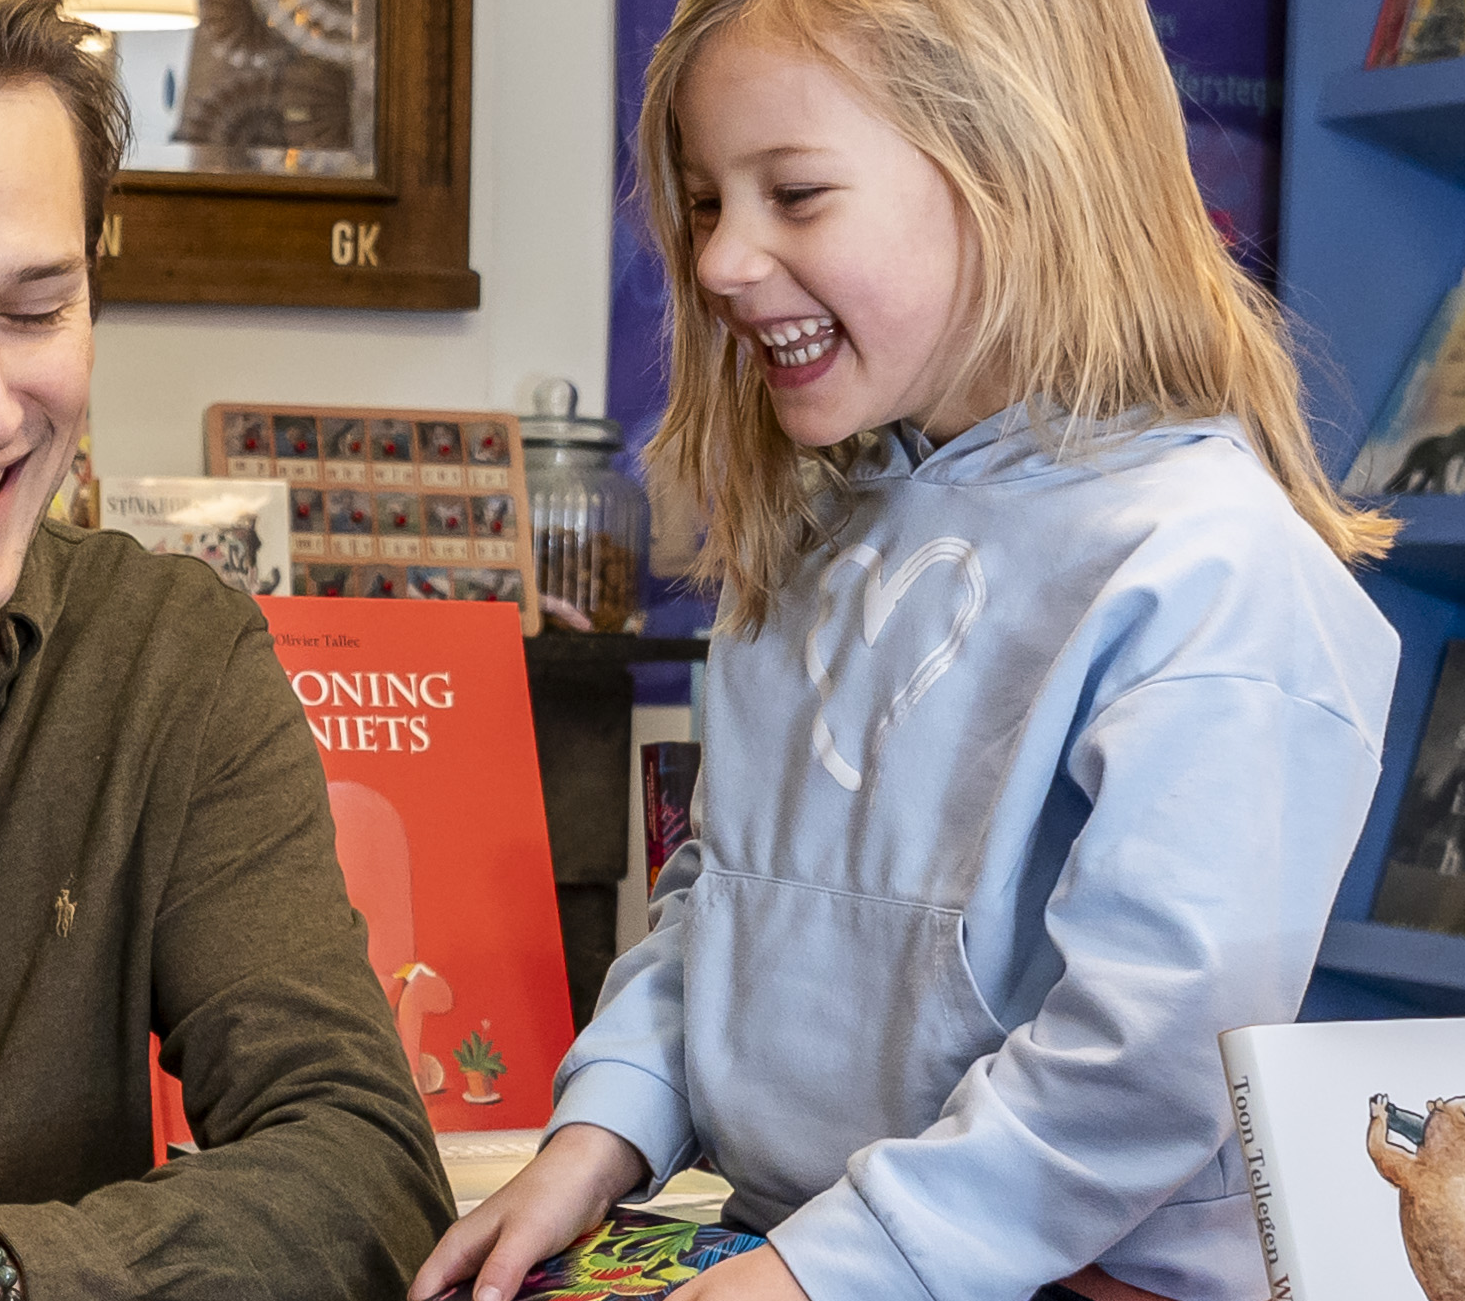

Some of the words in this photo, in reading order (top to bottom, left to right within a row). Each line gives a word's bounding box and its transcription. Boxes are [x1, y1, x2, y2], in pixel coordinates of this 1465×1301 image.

[330, 219, 393, 267] GK
[274, 632, 320, 650] Olivier
[323, 633, 362, 650] Tallec
[311, 714, 432, 755] NIETS
[1232, 1075, 1257, 1146] Toon
[1247, 1148, 1280, 1267] Tellegen
